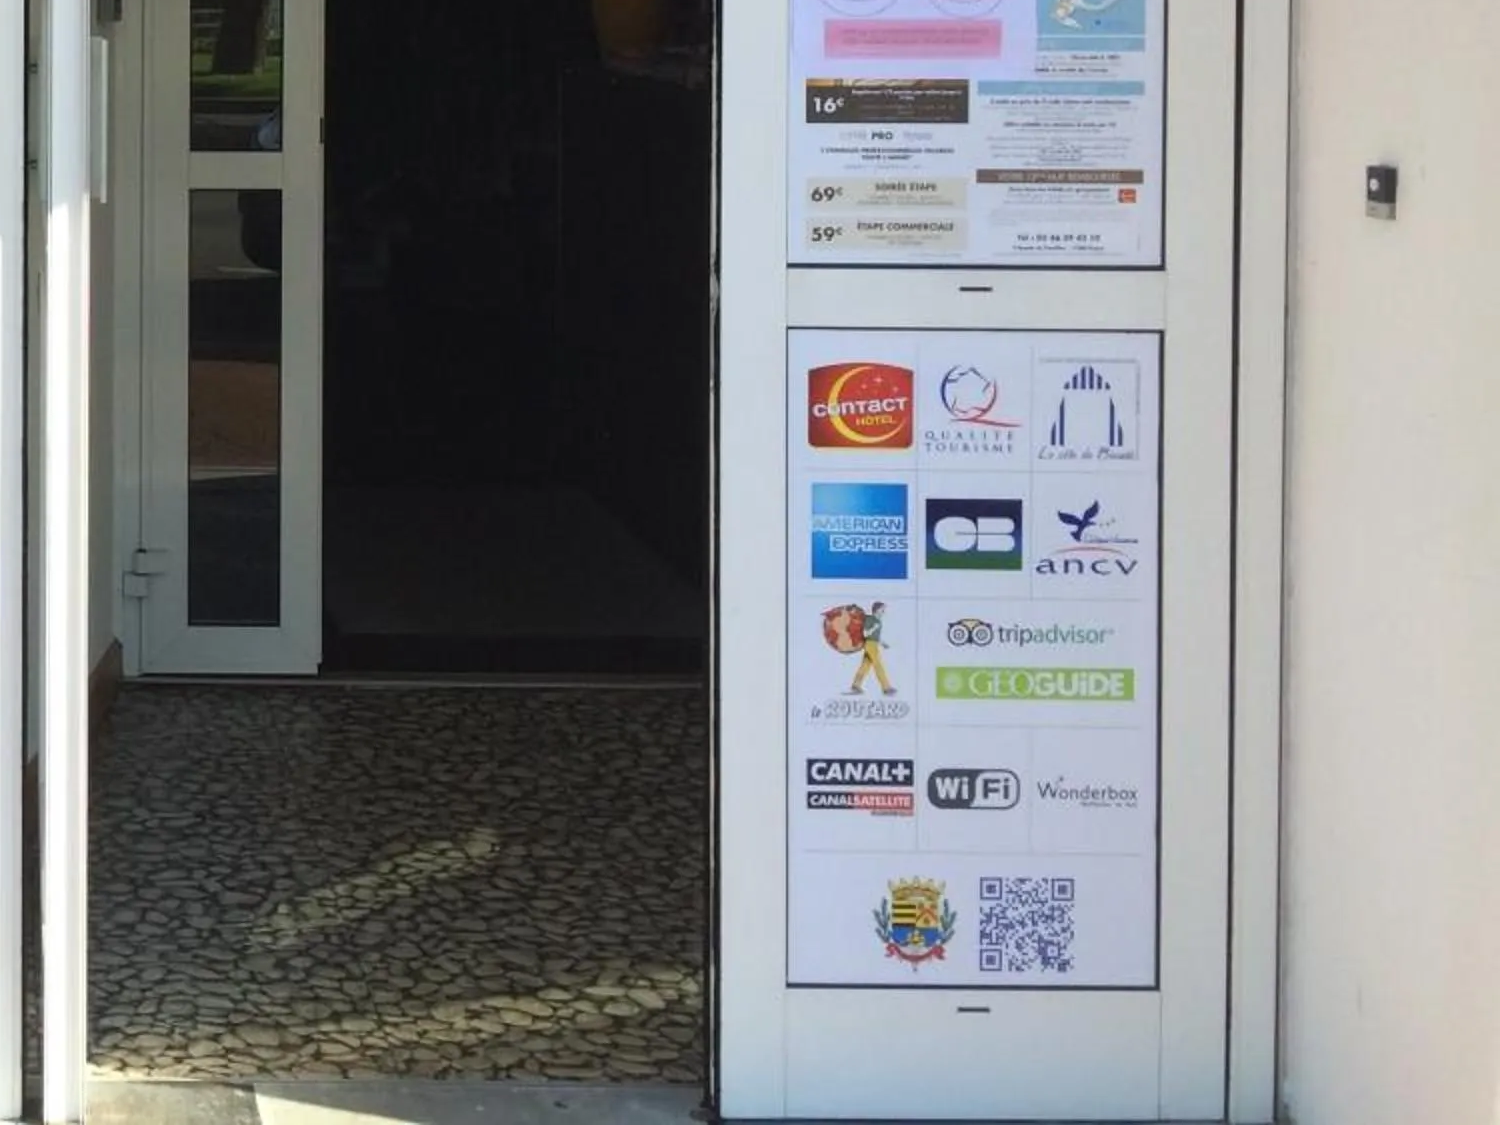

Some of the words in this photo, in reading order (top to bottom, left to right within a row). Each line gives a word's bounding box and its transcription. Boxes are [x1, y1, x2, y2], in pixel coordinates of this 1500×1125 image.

[871, 131, 893, 141] PRO
[886, 222, 954, 232] COMMERCIALE
[924, 442, 1014, 453] TOURISME
[813, 517, 902, 532] AMERICAN
[831, 536, 908, 550] EXPRESS
[1035, 557, 1138, 576] ancv
[998, 623, 1107, 647] tripadvisor
[824, 700, 910, 719] ROUTARD
[810, 762, 911, 782] CANAL+
[1037, 778, 1138, 801] Wonderbox
[810, 794, 911, 808] CANALSATELLITE
